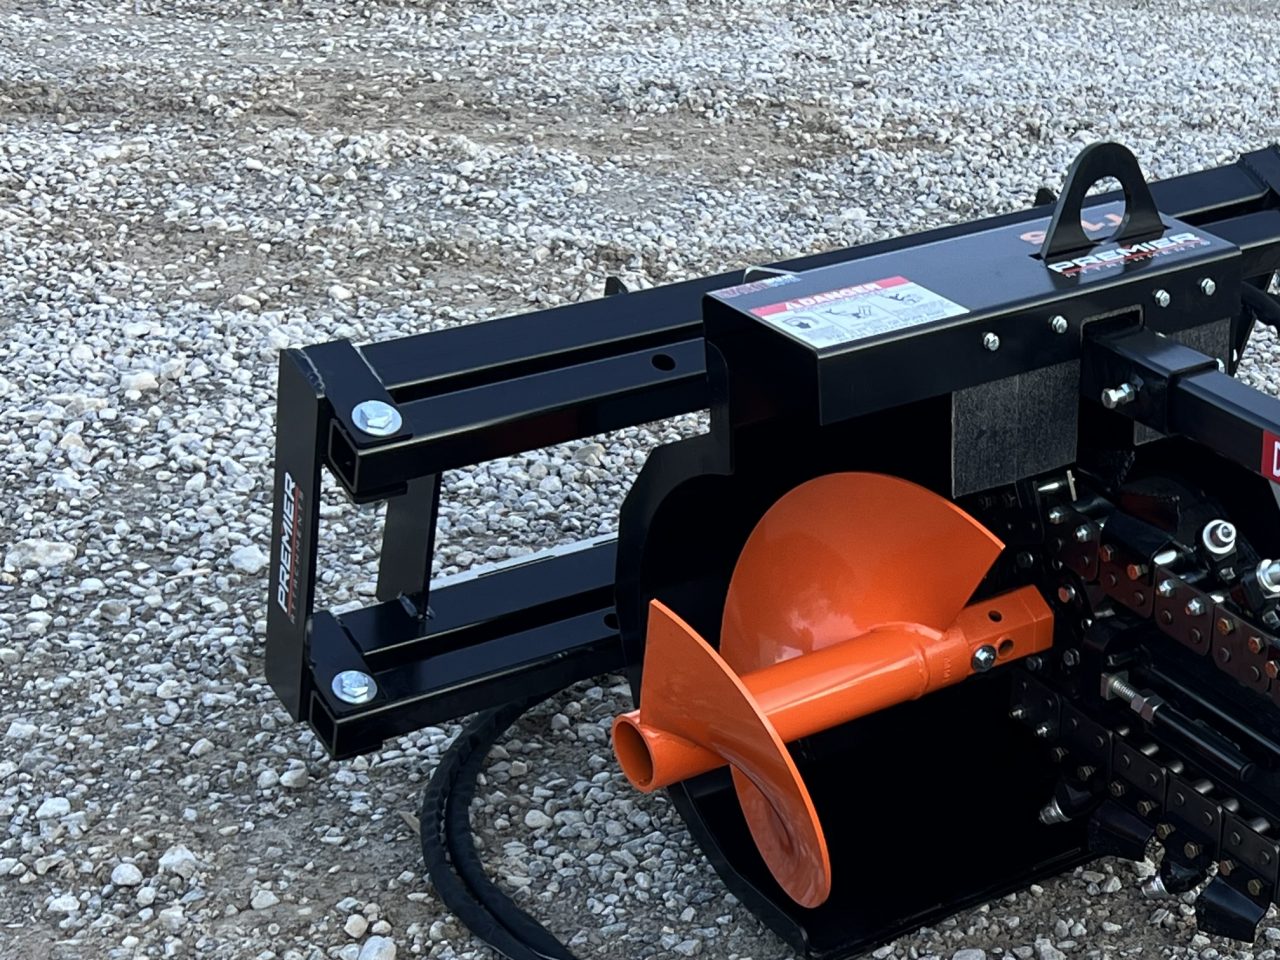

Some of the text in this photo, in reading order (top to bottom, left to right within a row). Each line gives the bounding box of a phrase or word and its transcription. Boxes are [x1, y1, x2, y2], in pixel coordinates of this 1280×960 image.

[1048, 231, 1200, 273] PREMIER
[804, 282, 883, 306] DANGER
[278, 472, 296, 613] PREMIER
